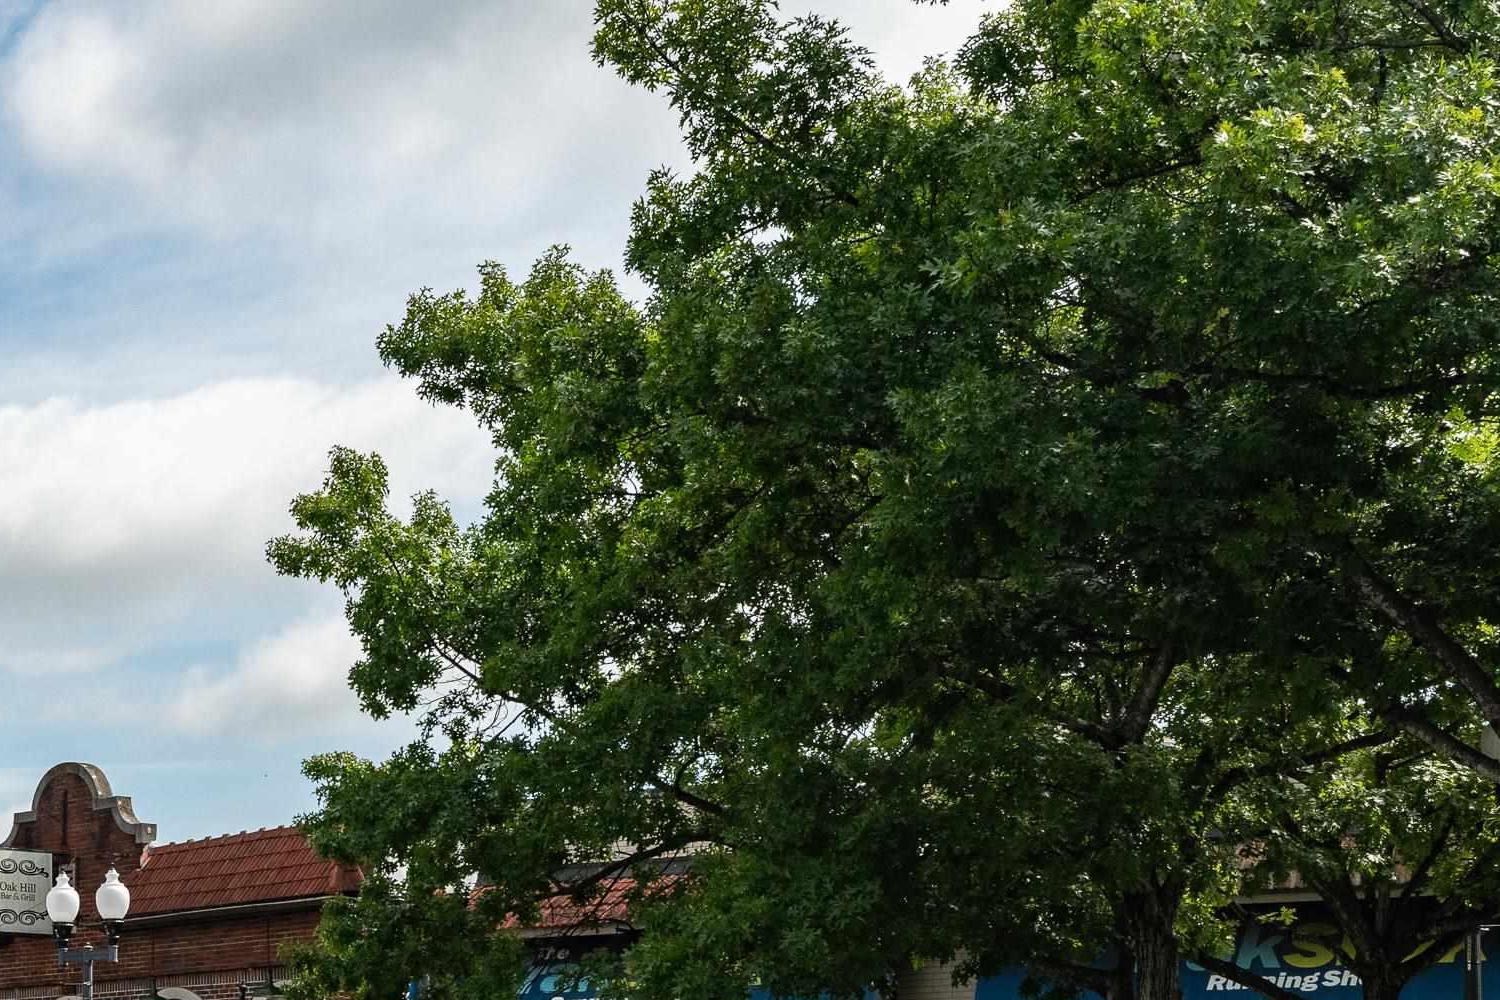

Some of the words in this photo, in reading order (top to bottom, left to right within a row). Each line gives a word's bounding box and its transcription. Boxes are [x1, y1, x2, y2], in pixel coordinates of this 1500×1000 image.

[0, 881, 18, 891] Oak
[20, 882, 36, 893] Hill
[1, 892, 12, 900] Bar
[1206, 972, 1320, 991] Ruing
[1322, 969, 1363, 988] Sh
